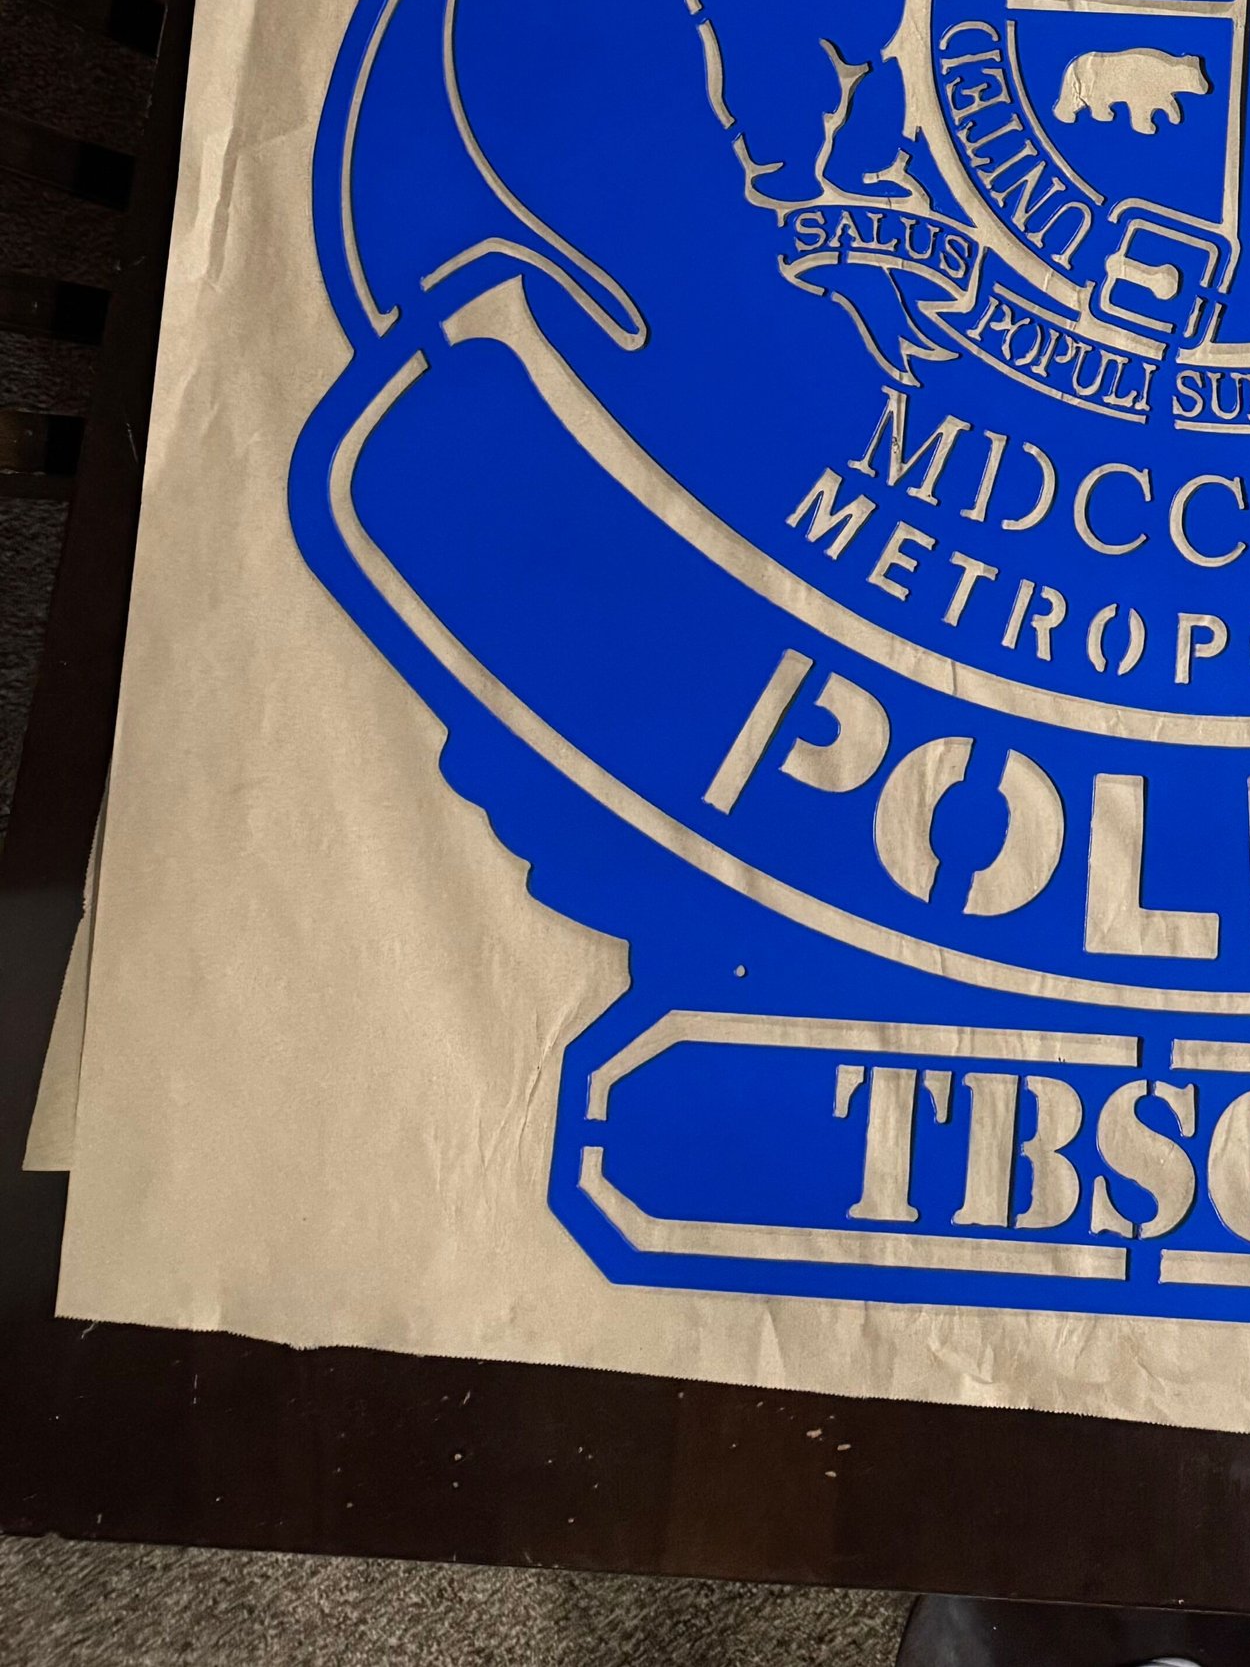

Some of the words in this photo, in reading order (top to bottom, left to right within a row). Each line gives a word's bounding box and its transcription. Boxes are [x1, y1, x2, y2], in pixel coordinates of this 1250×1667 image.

[940, 20, 1092, 271] UNITED
[794, 210, 974, 279] SALUS
[966, 296, 1161, 412] POPULI
